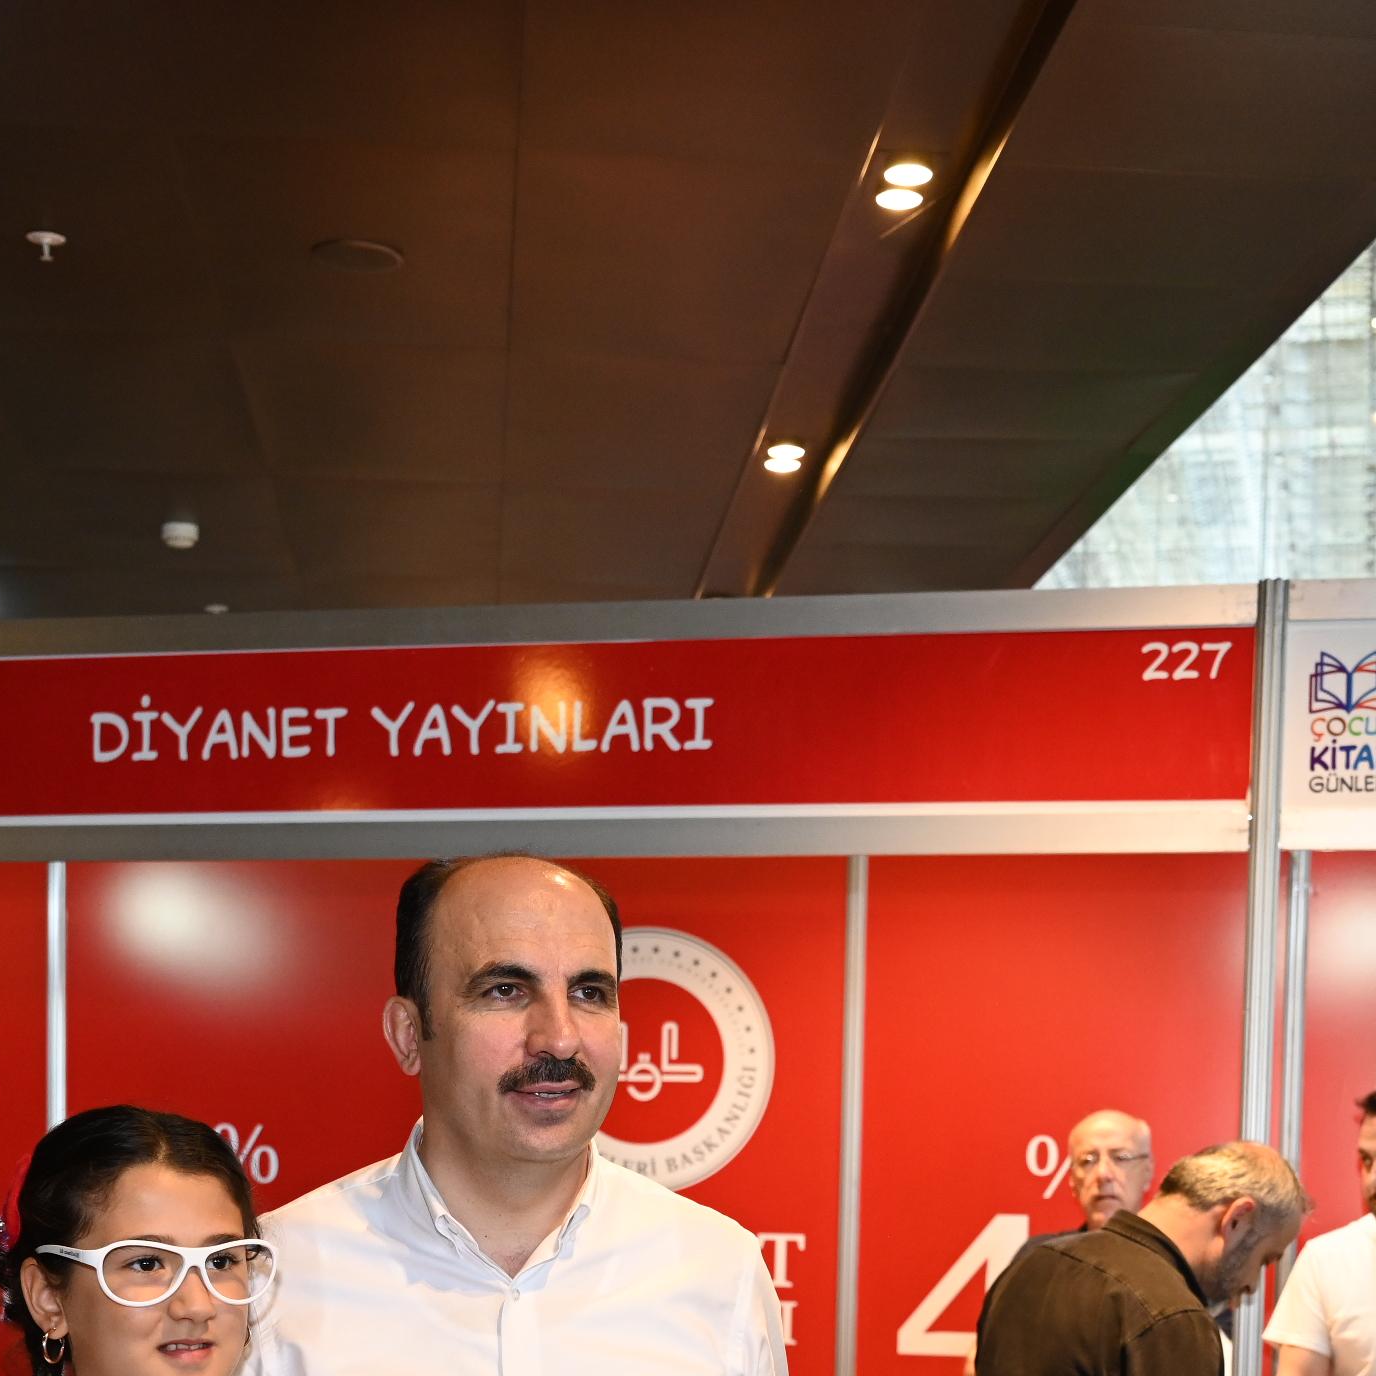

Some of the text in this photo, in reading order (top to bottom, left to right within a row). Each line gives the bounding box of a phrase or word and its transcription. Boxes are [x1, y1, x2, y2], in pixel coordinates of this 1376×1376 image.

[1141, 640, 1233, 682] 227
[89, 694, 714, 763] DİYANET YAYINLARI
